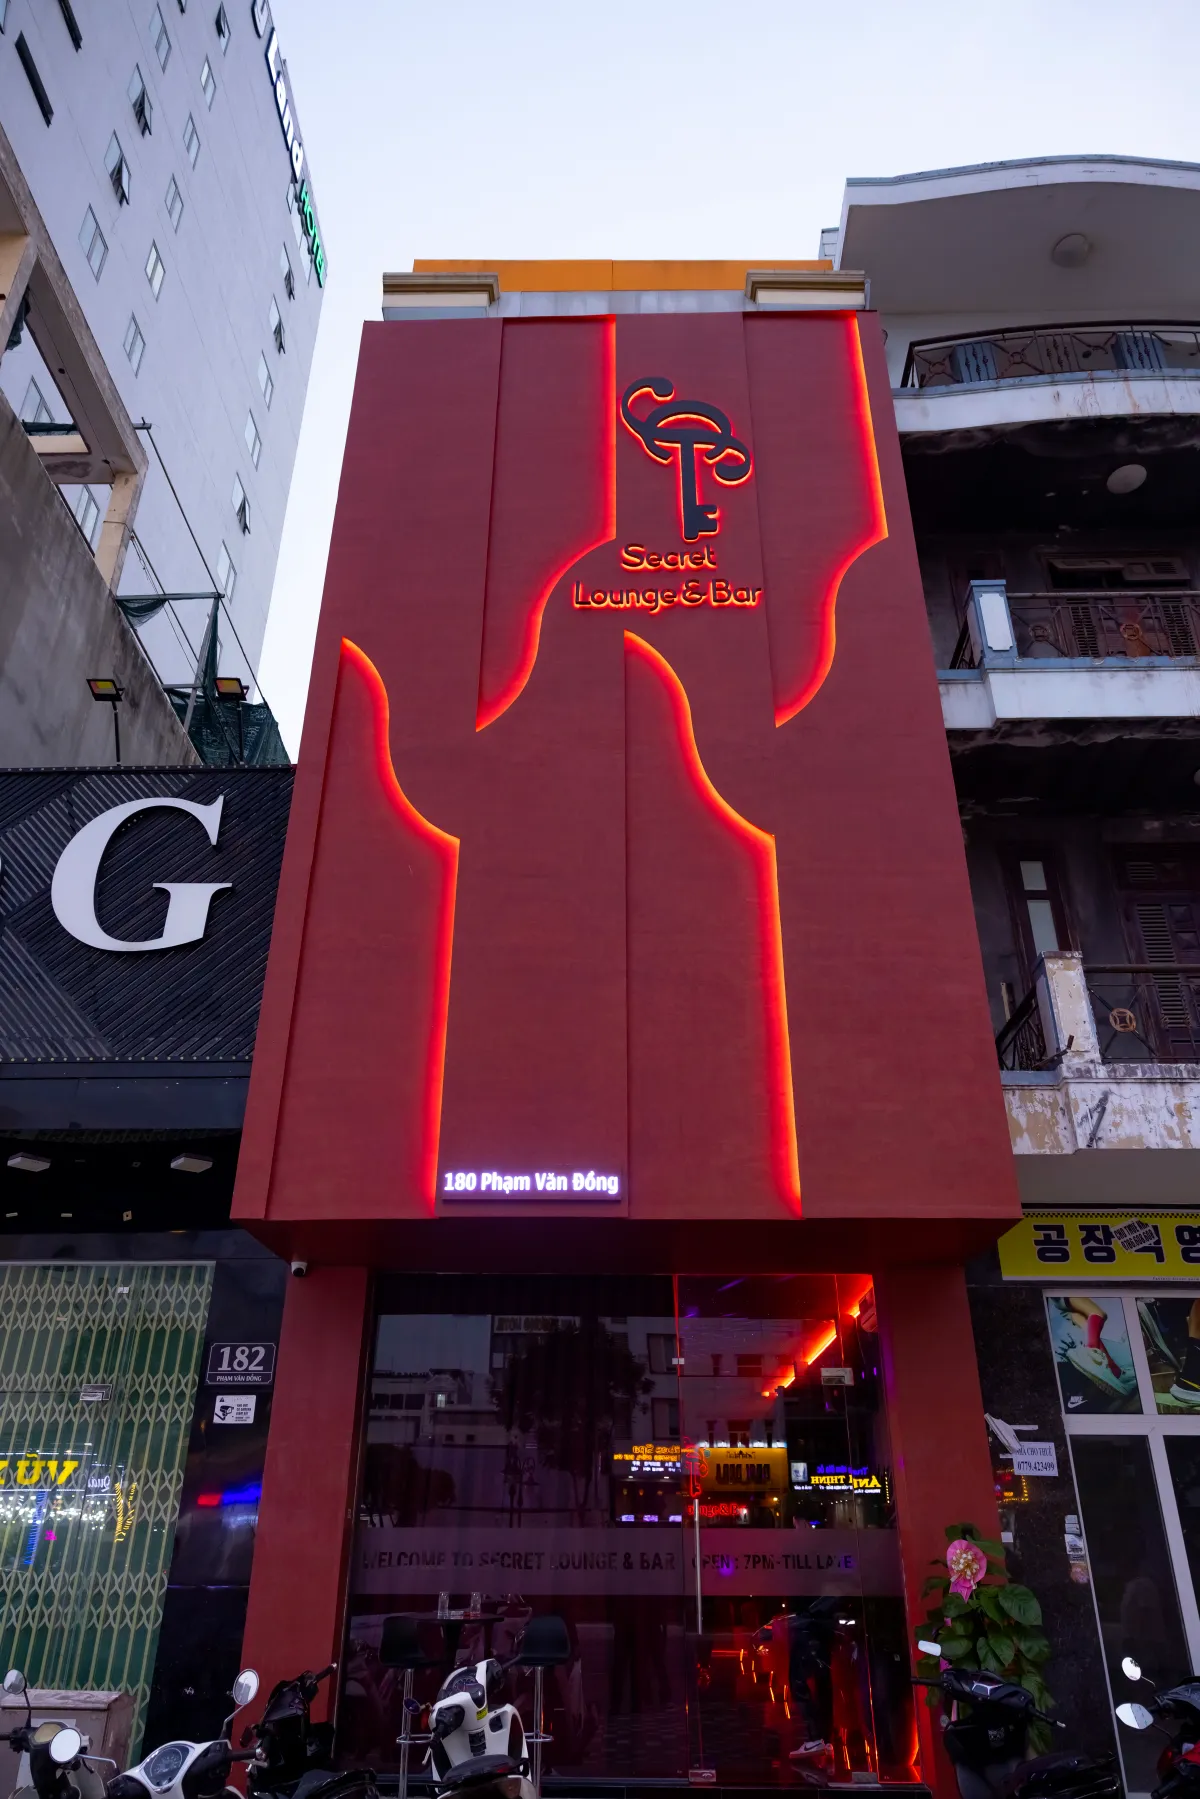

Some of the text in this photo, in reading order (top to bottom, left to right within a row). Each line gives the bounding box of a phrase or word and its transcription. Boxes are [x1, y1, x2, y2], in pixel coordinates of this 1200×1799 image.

[264, 27, 304, 183] Land
[299, 179, 325, 288] HOTEL
[620, 543, 718, 570] Secret
[573, 578, 763, 614] Lounge & Bar
[444, 1172, 477, 1191] 180
[480, 1171, 531, 1195] Phạm
[534, 1171, 568, 1191] Văn
[218, 1346, 266, 1371] 182
[452, 1551, 475, 1567] TO
[480, 1551, 547, 1569] SECRET
[622, 1552, 634, 1569] &
[639, 1552, 675, 1569] BAR
